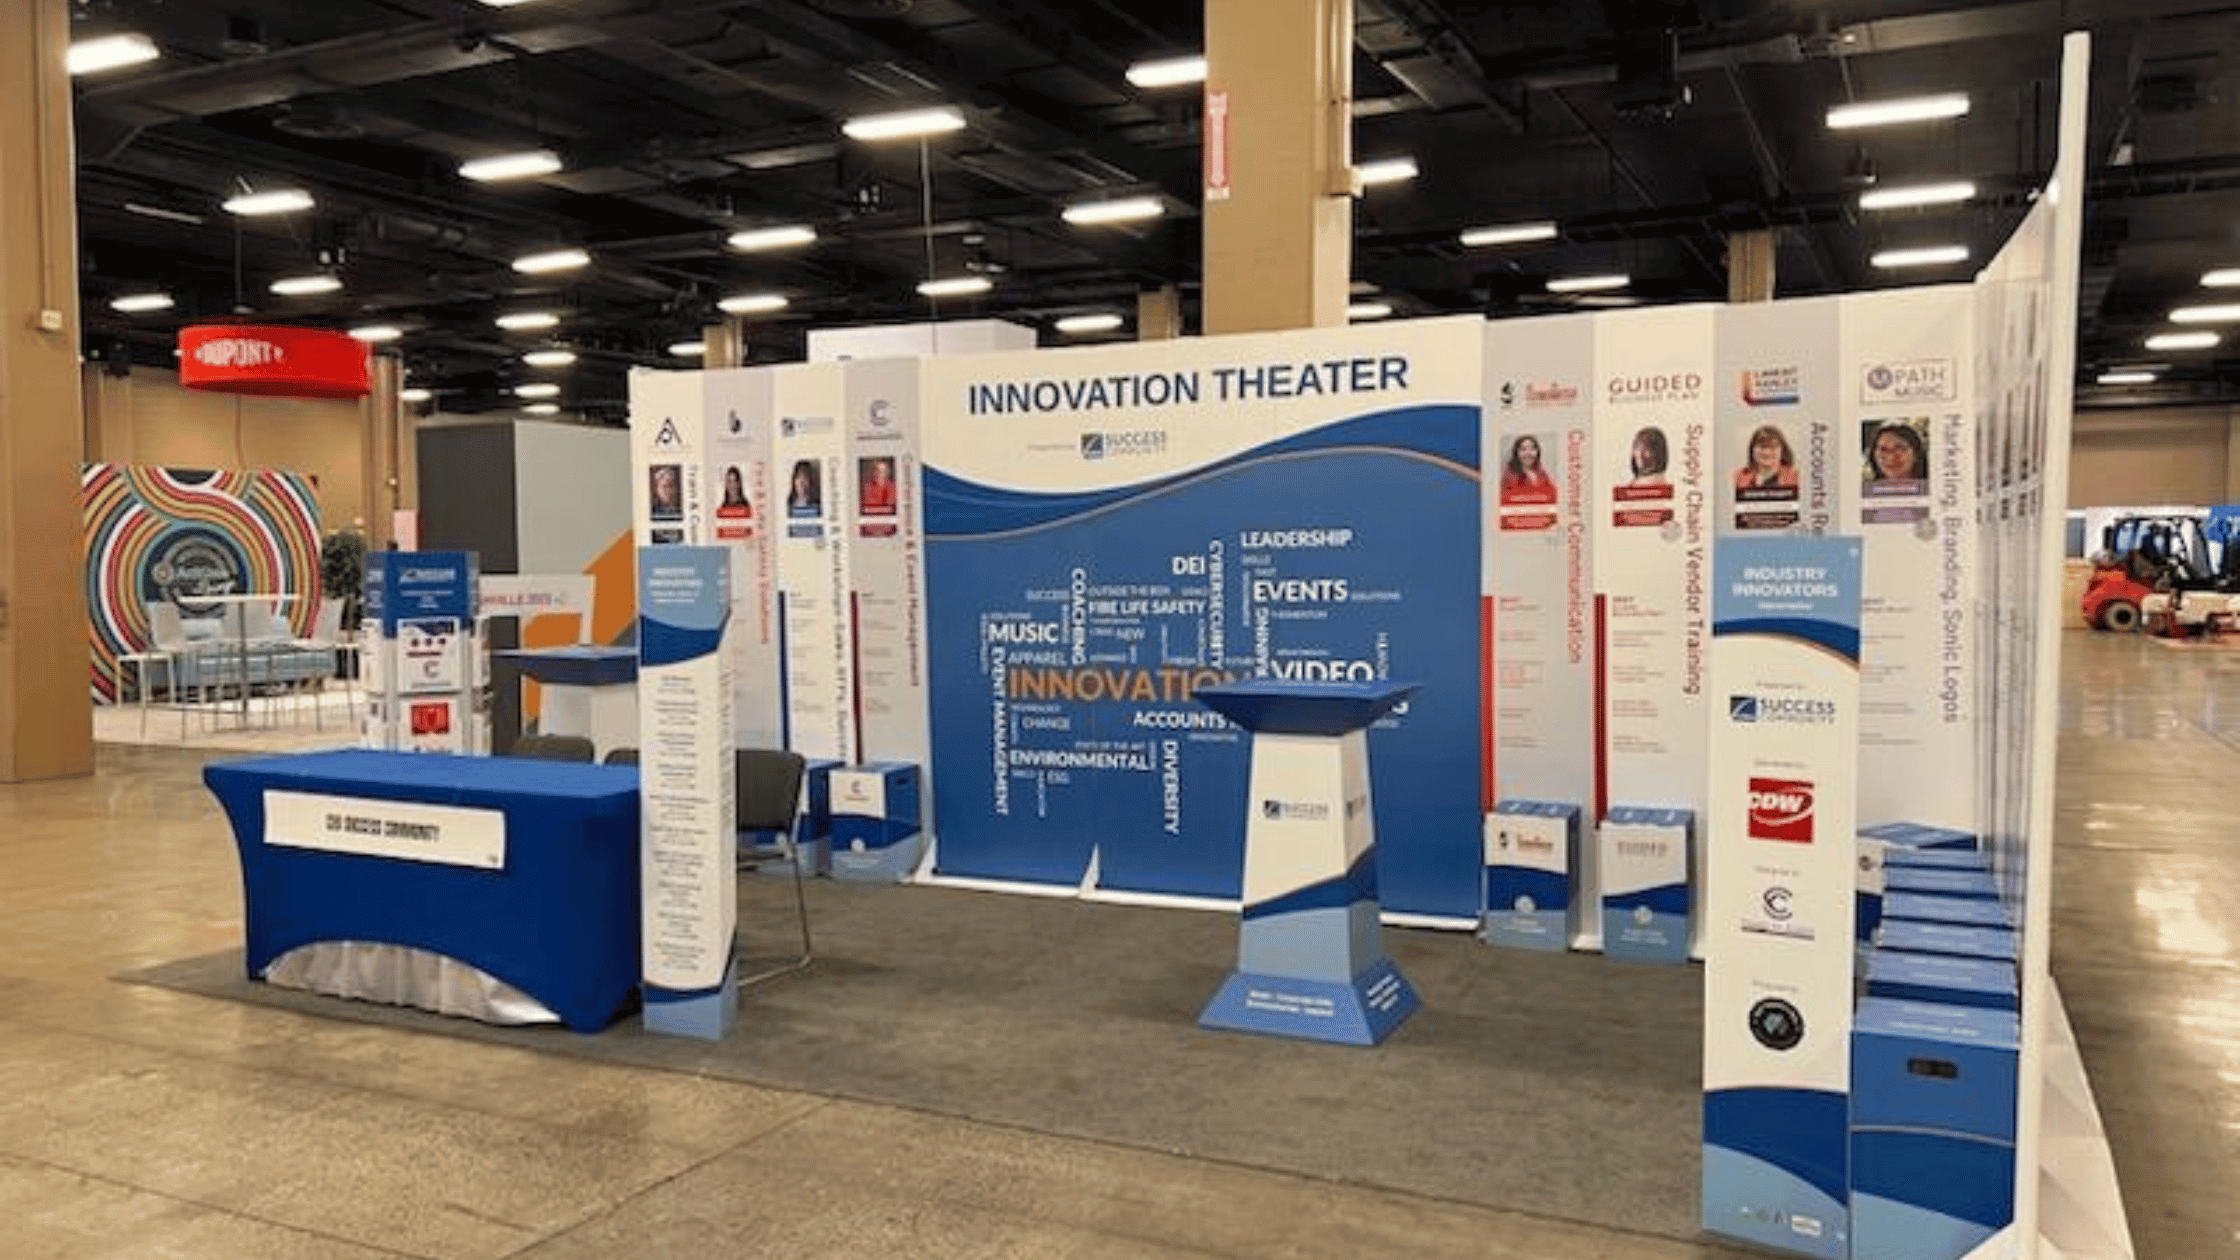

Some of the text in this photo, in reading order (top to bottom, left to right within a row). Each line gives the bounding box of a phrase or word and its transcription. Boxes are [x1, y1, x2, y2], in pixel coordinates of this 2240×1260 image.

[970, 357, 1408, 415] INNOVATION THEATER
[1609, 374, 1701, 395] GUIDED
[1810, 421, 1829, 510] Accounts
[1240, 529, 1352, 547] LEADERSHIP
[1567, 428, 1585, 664] Customer Communication
[1172, 556, 1205, 575] DEI
[1683, 424, 1704, 696] Supply Chain Vendor Training
[1743, 566, 1828, 581] INDUSTRY
[1253, 579, 1348, 602] EVENTS
[1732, 582, 1838, 598] INNOVATORS
[1089, 599, 1206, 615] FIRE LIFE SAFETY
[1209, 539, 1224, 670] CYBERSECURITY
[1072, 567, 1087, 666] COACHING
[987, 621, 1059, 644] MUSIC
[1942, 608, 1963, 662] Sonic
[1269, 659, 1374, 681] VIDEO
[1761, 696, 1836, 716] SUCCESS
[1940, 666, 1962, 723] Logos
[990, 645, 1010, 816] EVENT MANAGEMENT
[1132, 710, 1227, 730] ACCOUNTS
[1009, 749, 1150, 771] ENVIRONMENTAL
[1163, 739, 1181, 836] DIVERSITY
